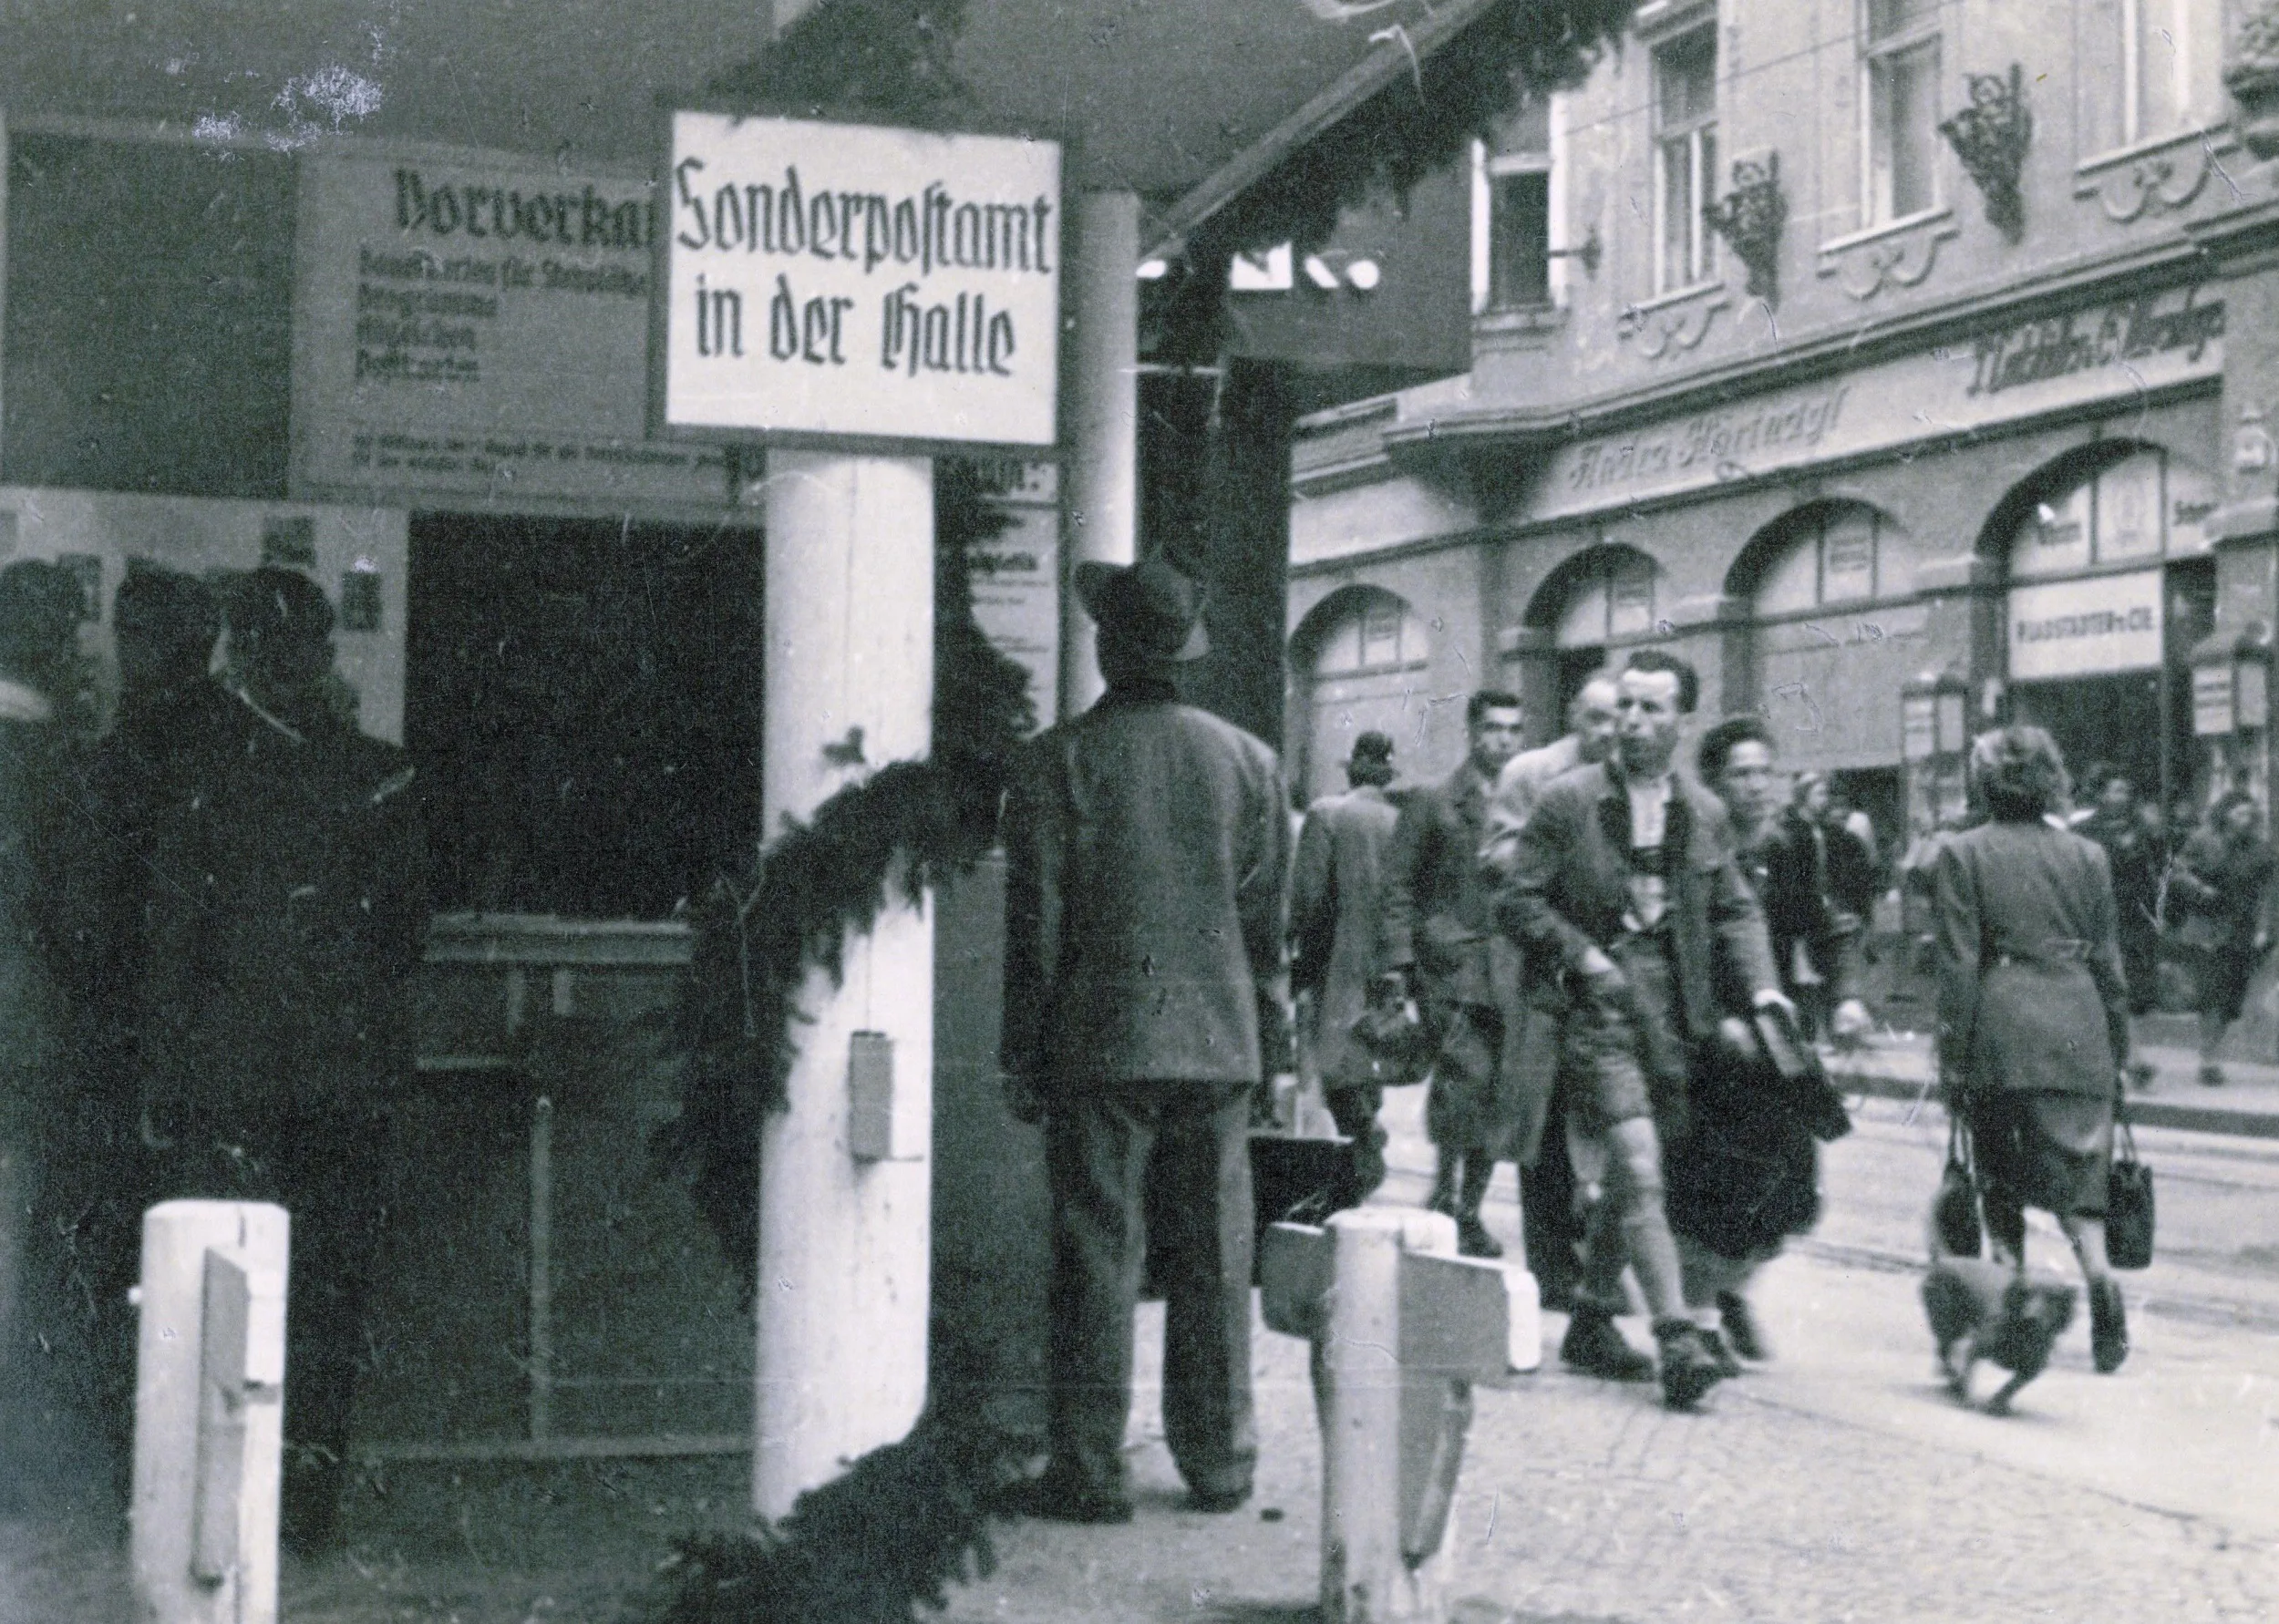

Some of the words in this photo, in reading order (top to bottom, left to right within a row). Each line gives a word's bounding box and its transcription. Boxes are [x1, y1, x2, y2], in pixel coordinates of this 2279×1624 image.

[696, 272, 746, 359] in
[769, 272, 855, 365] der
[881, 281, 1018, 379] Halle
